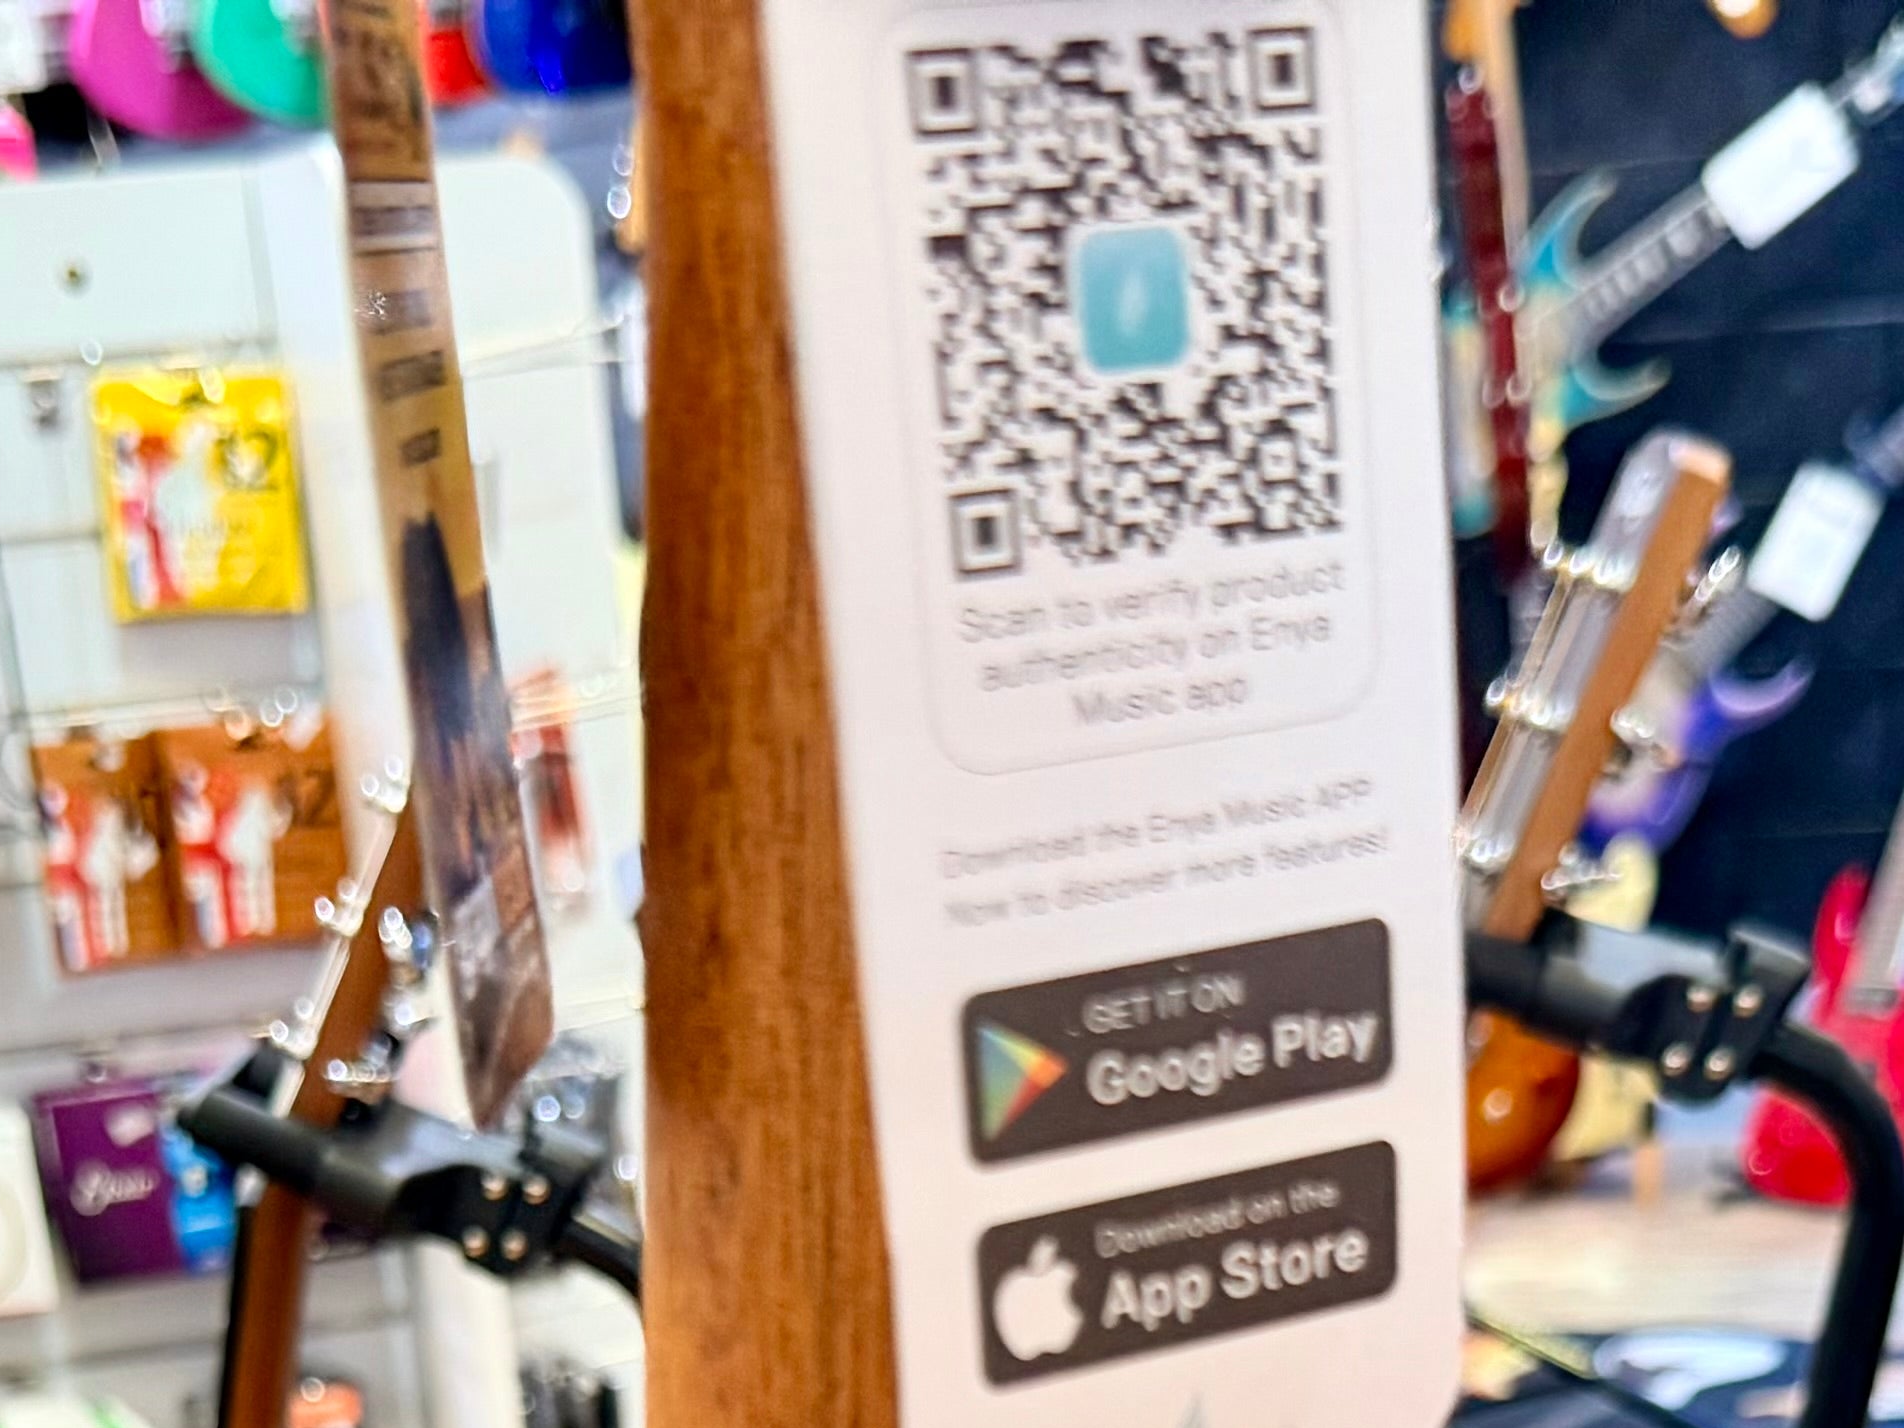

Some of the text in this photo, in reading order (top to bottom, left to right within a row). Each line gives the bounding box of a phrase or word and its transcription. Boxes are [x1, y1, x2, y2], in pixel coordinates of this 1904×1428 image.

[960, 562, 1346, 644] Scan to verify product
[980, 613, 1332, 692] authenticity on Enya
[1072, 676, 1248, 724] Music app
[1083, 972, 1244, 1034] GET IT ON
[1086, 1008, 1378, 1105] Google Play
[1096, 1178, 1341, 1259] Download on the
[1100, 1228, 1369, 1332] App Store
